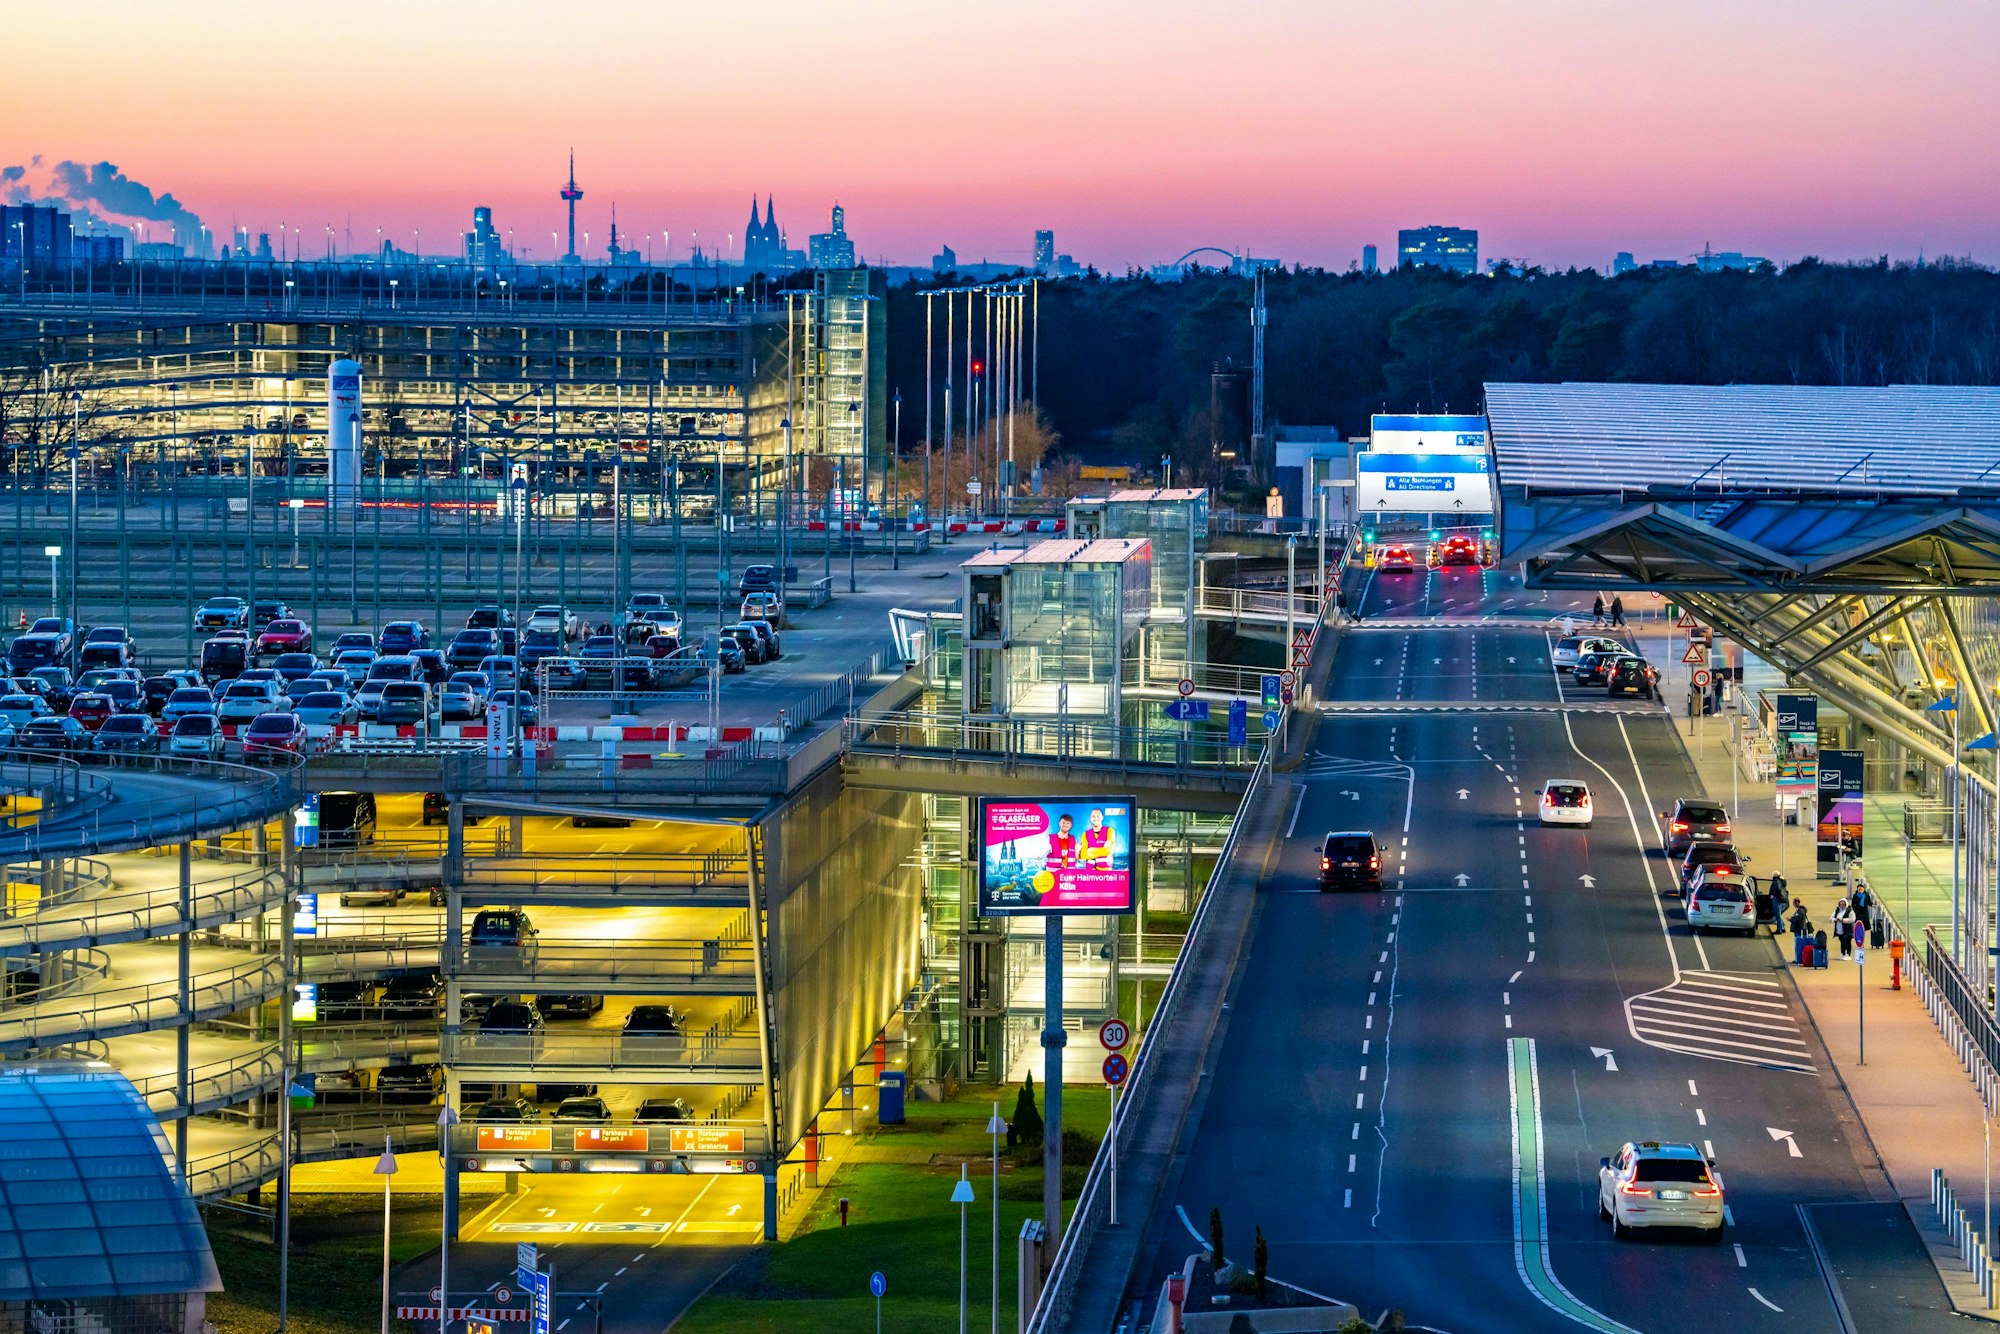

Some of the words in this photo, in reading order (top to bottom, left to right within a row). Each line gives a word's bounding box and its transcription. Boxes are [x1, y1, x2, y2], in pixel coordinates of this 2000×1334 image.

[1180, 702, 1190, 718] P
[1106, 1027, 1123, 1042] 30
[501, 1292, 506, 1300] 5
